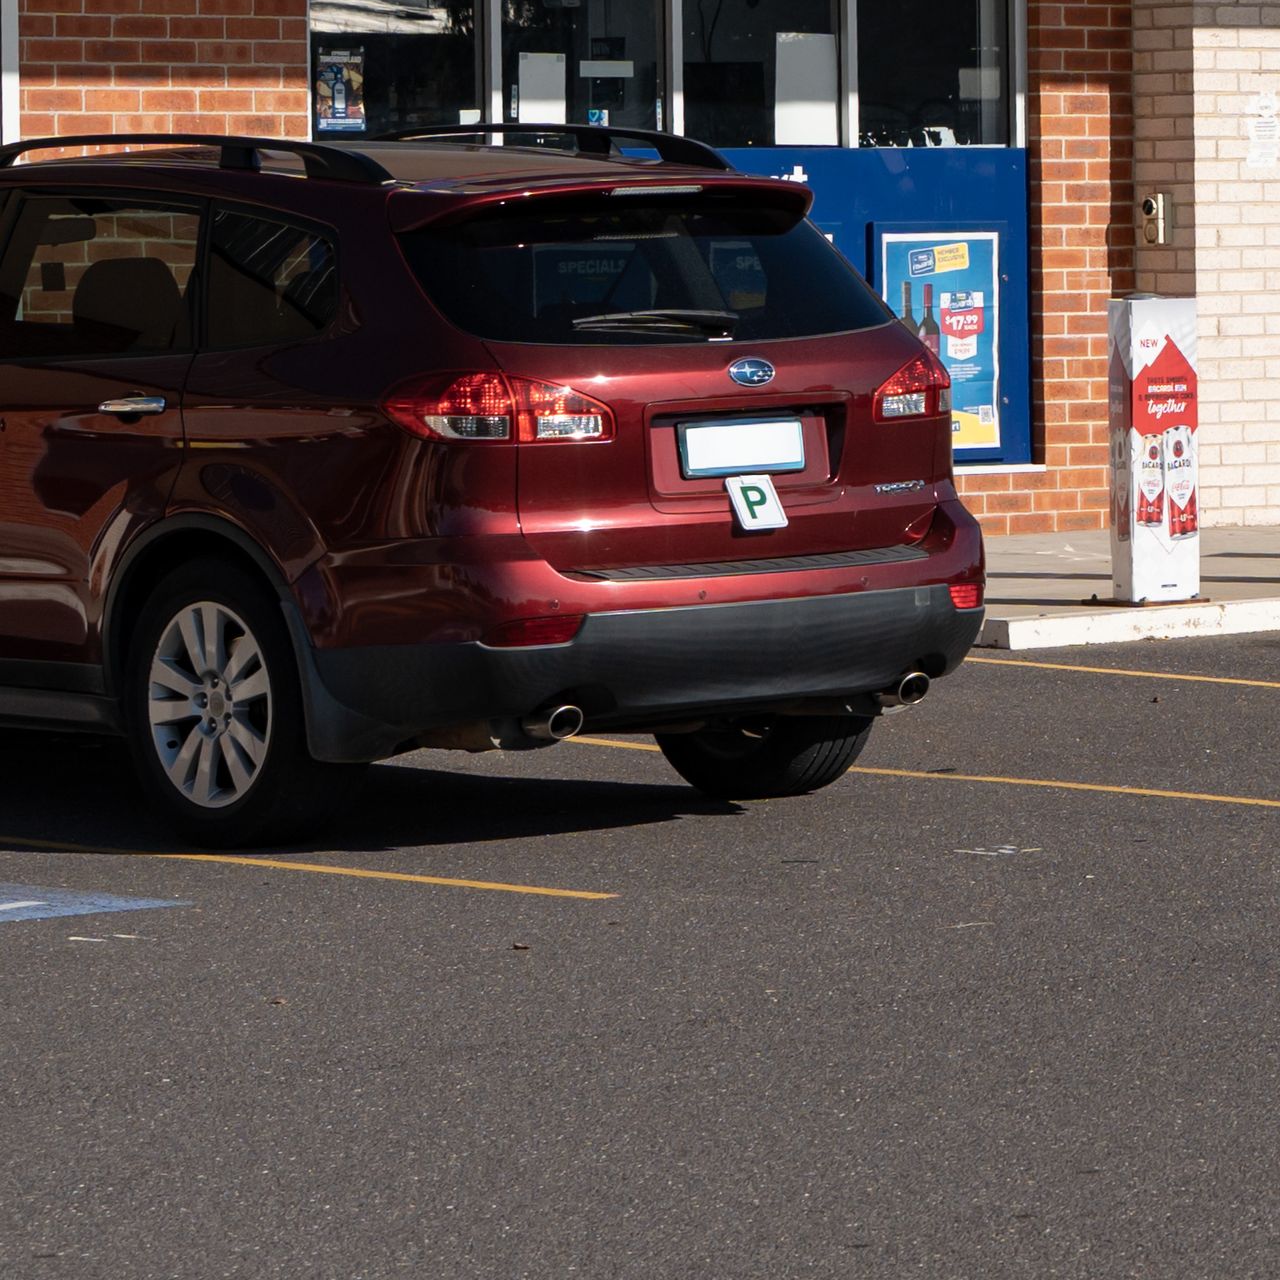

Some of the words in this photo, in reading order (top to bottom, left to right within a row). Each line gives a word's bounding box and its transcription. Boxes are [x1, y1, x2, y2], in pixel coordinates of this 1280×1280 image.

[945, 315, 978, 331] $17.99
[1140, 339, 1158, 348] NEW
[1147, 399, 1187, 419] together
[741, 486, 767, 519] P
